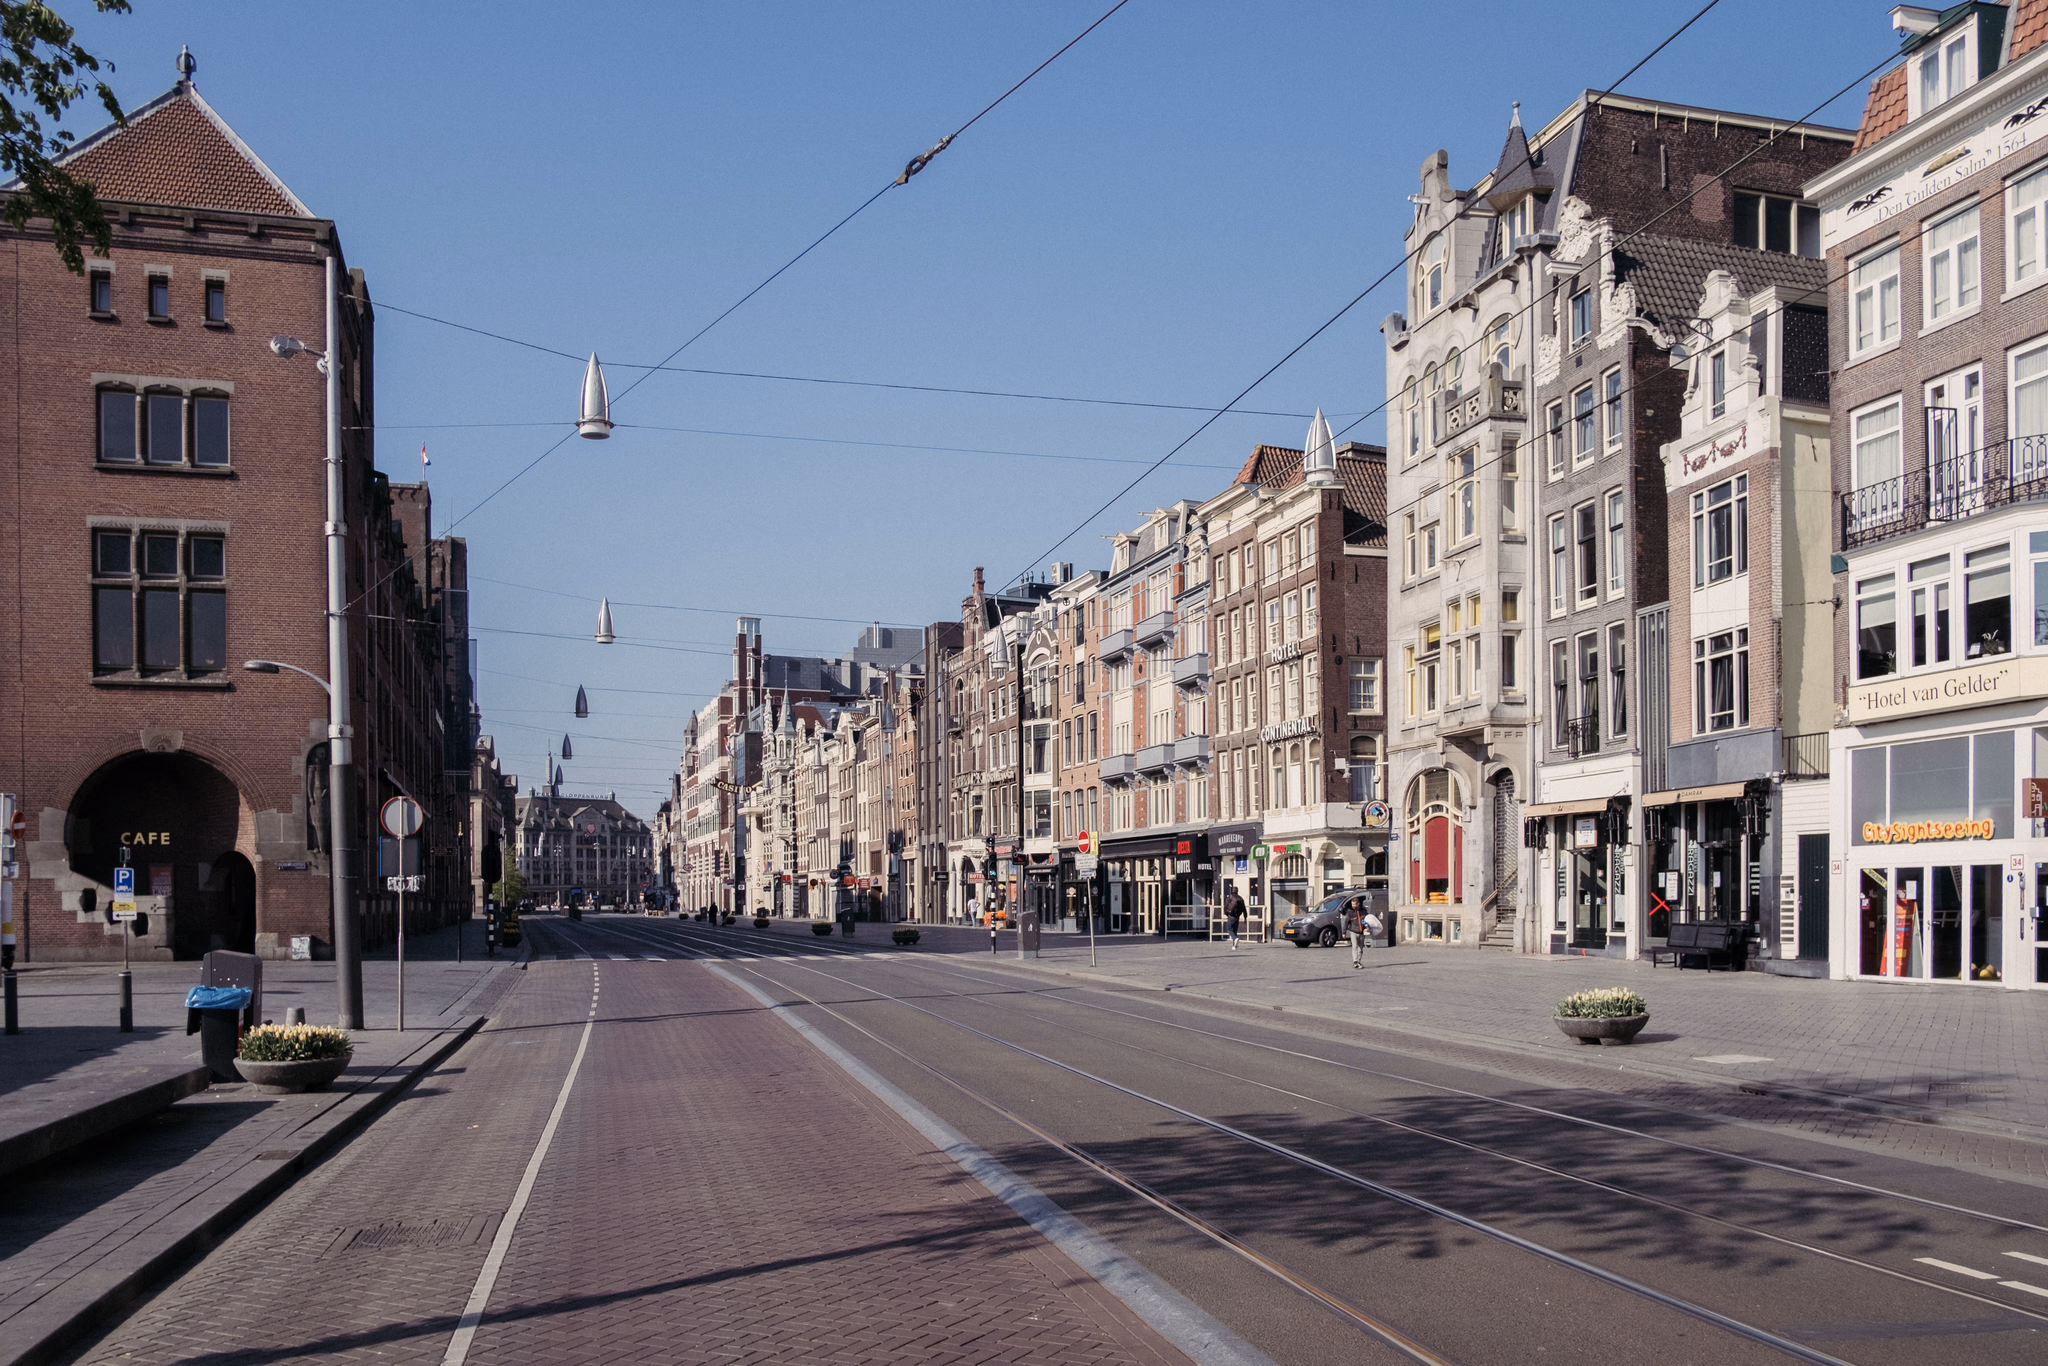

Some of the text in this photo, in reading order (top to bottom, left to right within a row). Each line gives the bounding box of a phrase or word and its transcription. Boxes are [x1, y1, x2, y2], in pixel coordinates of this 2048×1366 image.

[1904, 176, 1952, 206] Gulden
[1997, 131, 2027, 160] 1564
[1271, 641, 1297, 663] HOTEL
[1911, 685, 1939, 703] van
[1261, 717, 1311, 742] CONTINENTAL
[717, 781, 752, 795] CASIO
[1681, 790, 1703, 798] DAMRAK
[120, 831, 171, 846] CAFE
[1862, 818, 1995, 844] CitySightseeing
[1177, 840, 1191, 855] DELTA
[1176, 859, 1191, 874] HOTEL
[1197, 862, 1213, 871] HOTEL
[1832, 863, 1841, 871] 34
[2012, 858, 2022, 867] 34
[118, 870, 130, 884] P
[1687, 848, 1695, 896] RAGAZZI
[1867, 869, 1886, 885] DISCOUNT
